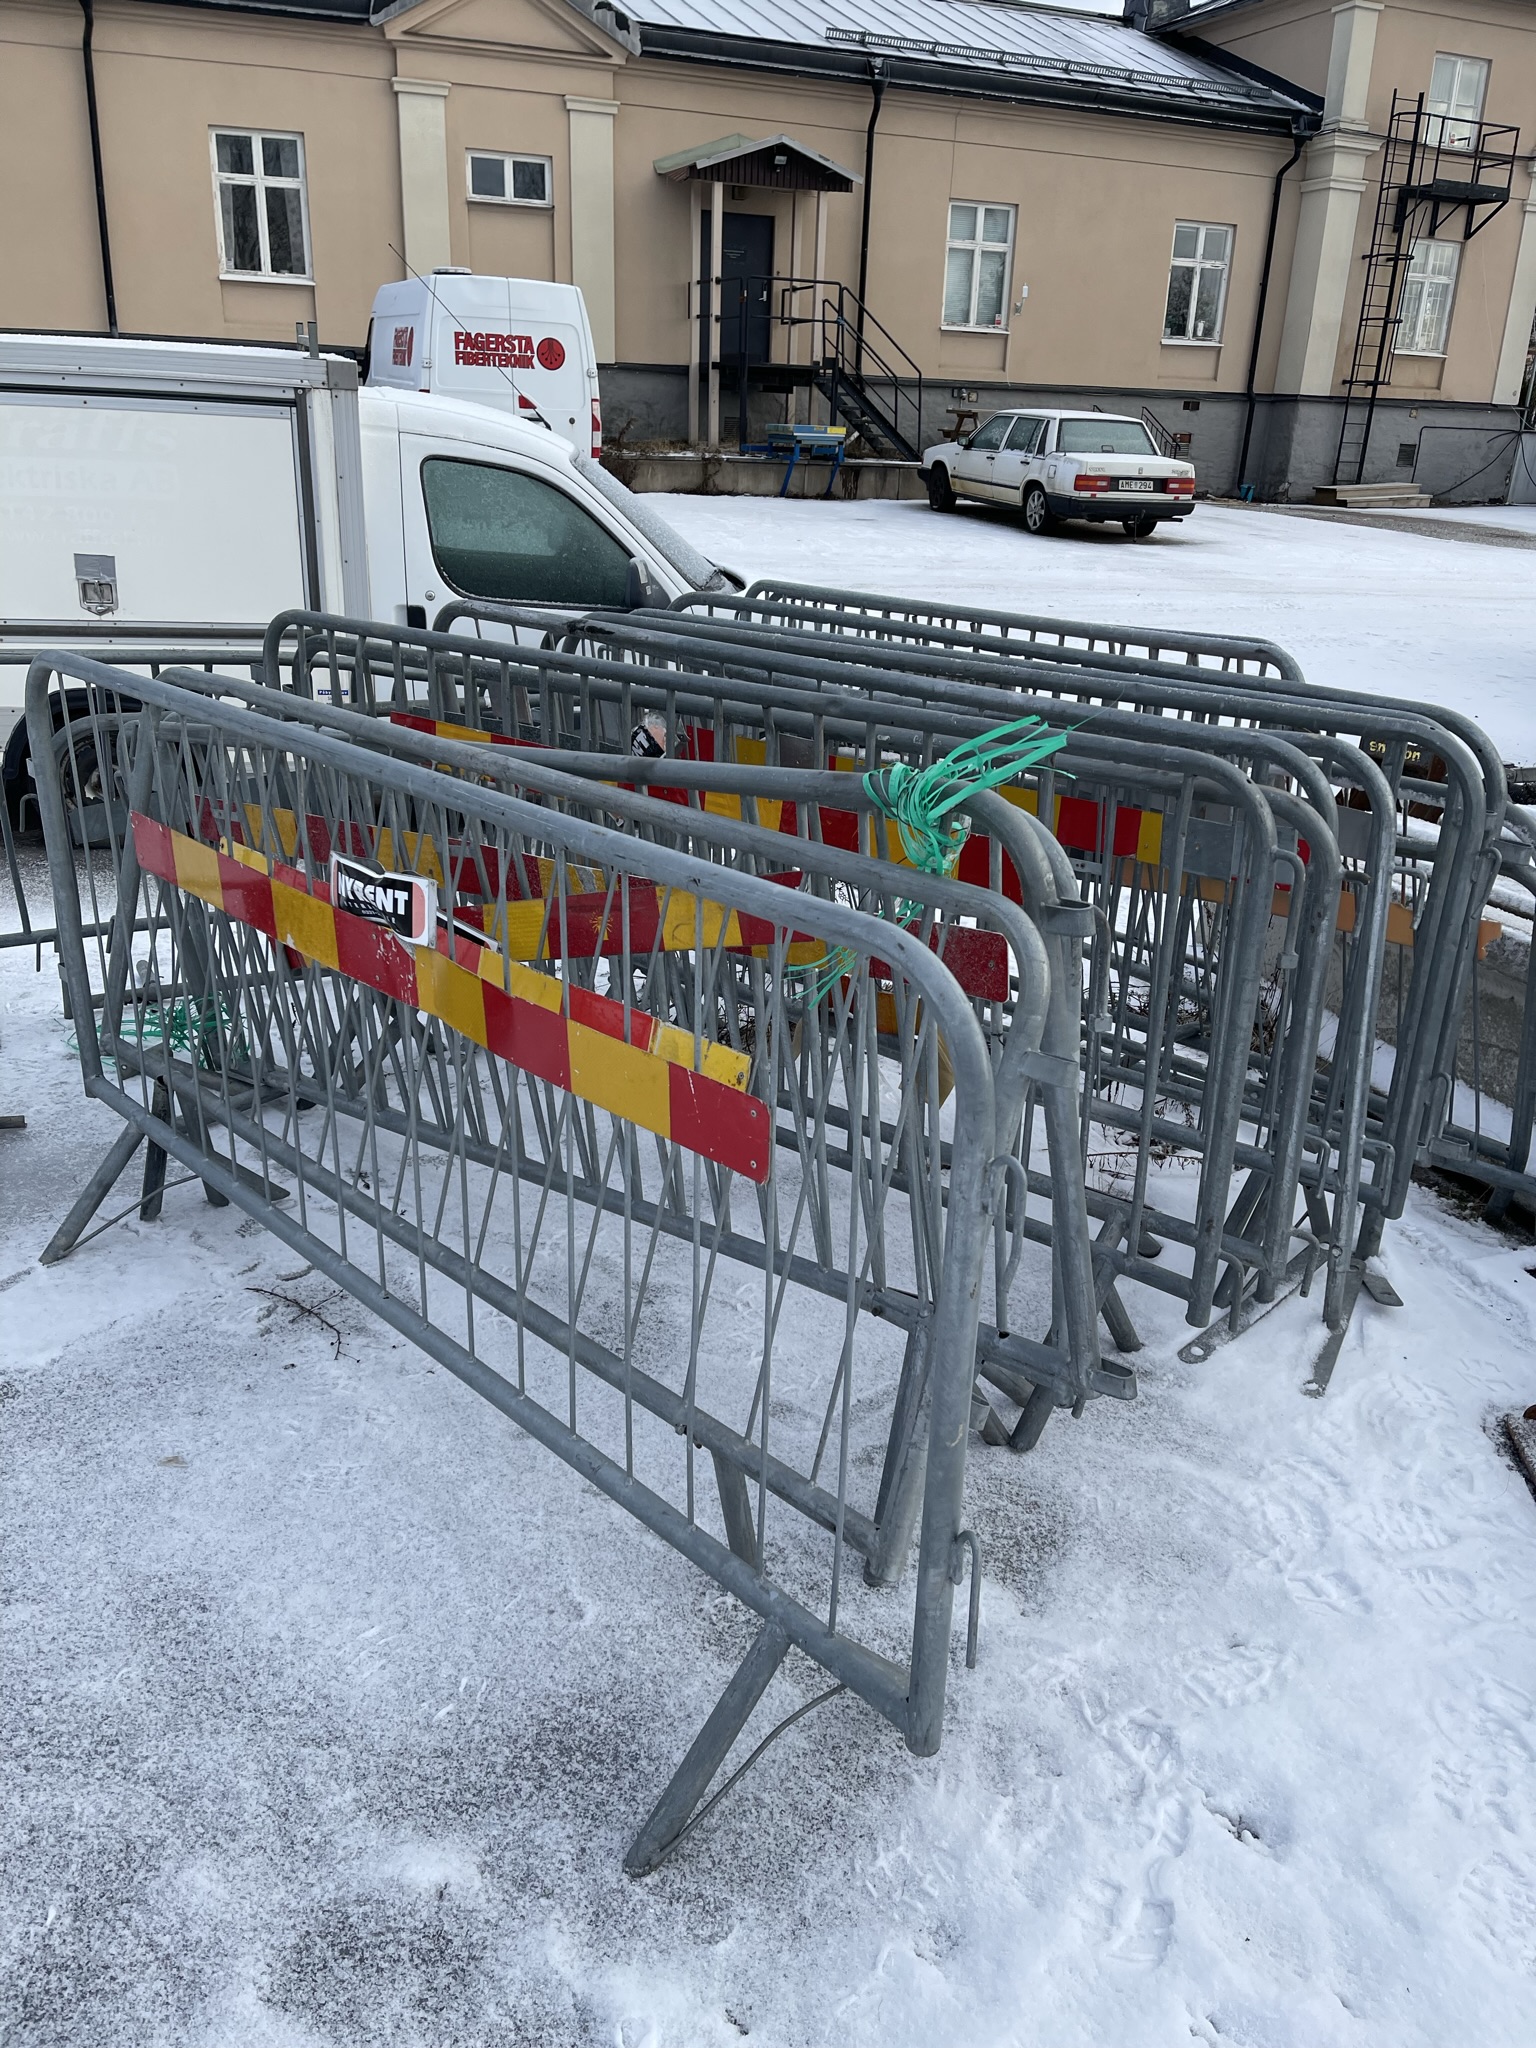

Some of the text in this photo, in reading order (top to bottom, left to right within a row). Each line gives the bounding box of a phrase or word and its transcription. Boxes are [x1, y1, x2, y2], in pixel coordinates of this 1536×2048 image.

[454, 331, 535, 354] FAGERSTA
[455, 350, 535, 369] FIBERTEKNIK
[1120, 480, 1152, 490] AME 294
[338, 871, 409, 916] NYRENT
